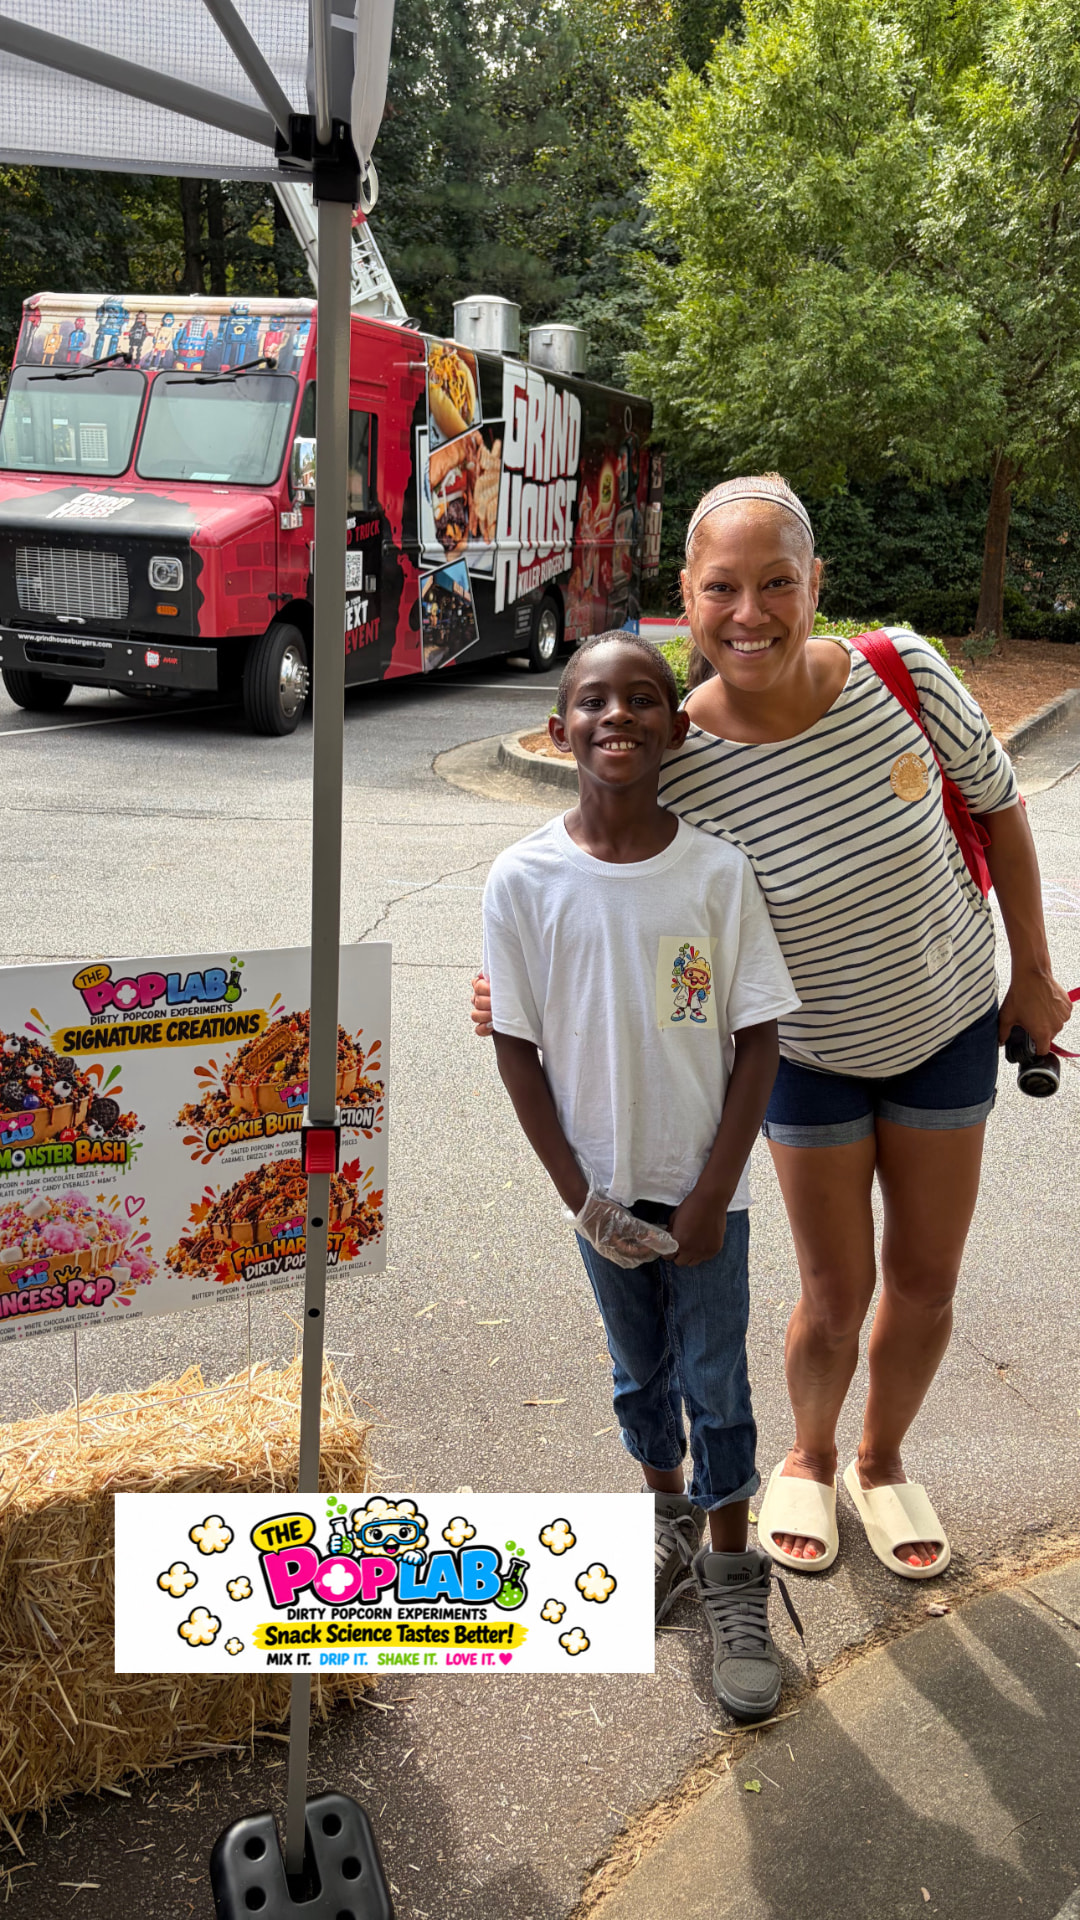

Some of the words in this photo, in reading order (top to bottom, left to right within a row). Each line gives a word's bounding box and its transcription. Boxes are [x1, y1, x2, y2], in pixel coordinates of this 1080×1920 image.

[503, 361, 582, 482] GRIND
[355, 520, 380, 543] TRUCK
[494, 472, 578, 614] HOUSE
[518, 565, 541, 599] KILLER
[345, 599, 369, 632] EXT
[17, 633, 113, 648] www.grindhouseburgers.com
[345, 617, 381, 656] EVENT
[79, 968, 105, 987] THE
[90, 1013, 119, 1026] DIRTY
[123, 1009, 167, 1022] POPCORN
[170, 1004, 233, 1018] EXPERIMENTS
[62, 1022, 163, 1051] SIGNATURE
[166, 1014, 261, 1042] CREATIONS
[1, 1124, 34, 1145] LAB
[207, 1121, 263, 1150] COOKIE
[265, 1112, 304, 1136] BUTT
[340, 1107, 374, 1127] CTION
[75, 1139, 126, 1164] BASH
[221, 1155, 245, 1164] CARAMEL
[246, 1152, 267, 1161] DRIZZLE
[275, 1148, 297, 1157] CRUSHED
[231, 1147, 249, 1155] SALTED
[250, 1144, 275, 1153] POPCORN
[281, 1140, 299, 1148] COOKIE
[0, 1181, 18, 1189] CORN
[26, 1178, 40, 1186] DARK
[42, 1174, 75, 1184] CHOCOLATE
[76, 1171, 98, 1179] DRIZZLE
[0, 1190, 14, 1198] LATE
[42, 1184, 61, 1192] CANDY
[62, 1180, 90, 1189] EYEBALLS
[232, 1244, 272, 1271] FALL
[273, 1233, 344, 1257] HARST
[8, 1260, 50, 1284] POP
[245, 1258, 282, 1279] DIRTY
[284, 1250, 338, 1269] POPN
[326, 1264, 348, 1273] OCOLATE
[17, 1270, 48, 1289] LAB
[67, 1277, 114, 1306] POP
[192, 1291, 214, 1300] BUTTERY
[216, 1286, 239, 1295] POPCORN
[246, 1280, 268, 1290] CARAMEL
[269, 1276, 289, 1285] DRIZZLE
[246, 1289, 266, 1297] PECANS
[271, 1281, 300, 1292] CHOCOLATE
[0, 1327, 15, 1335] CORN
[24, 1322, 41, 1330] WHITE
[43, 1316, 75, 1326] CHOCOLATE
[77, 1311, 99, 1320] DRIZZLE
[25, 1328, 52, 1337] RAINBOW
[53, 1322, 82, 1332] SPRINKLES
[103, 1314, 124, 1323] COTTON
[125, 1311, 143, 1320] CANDY
